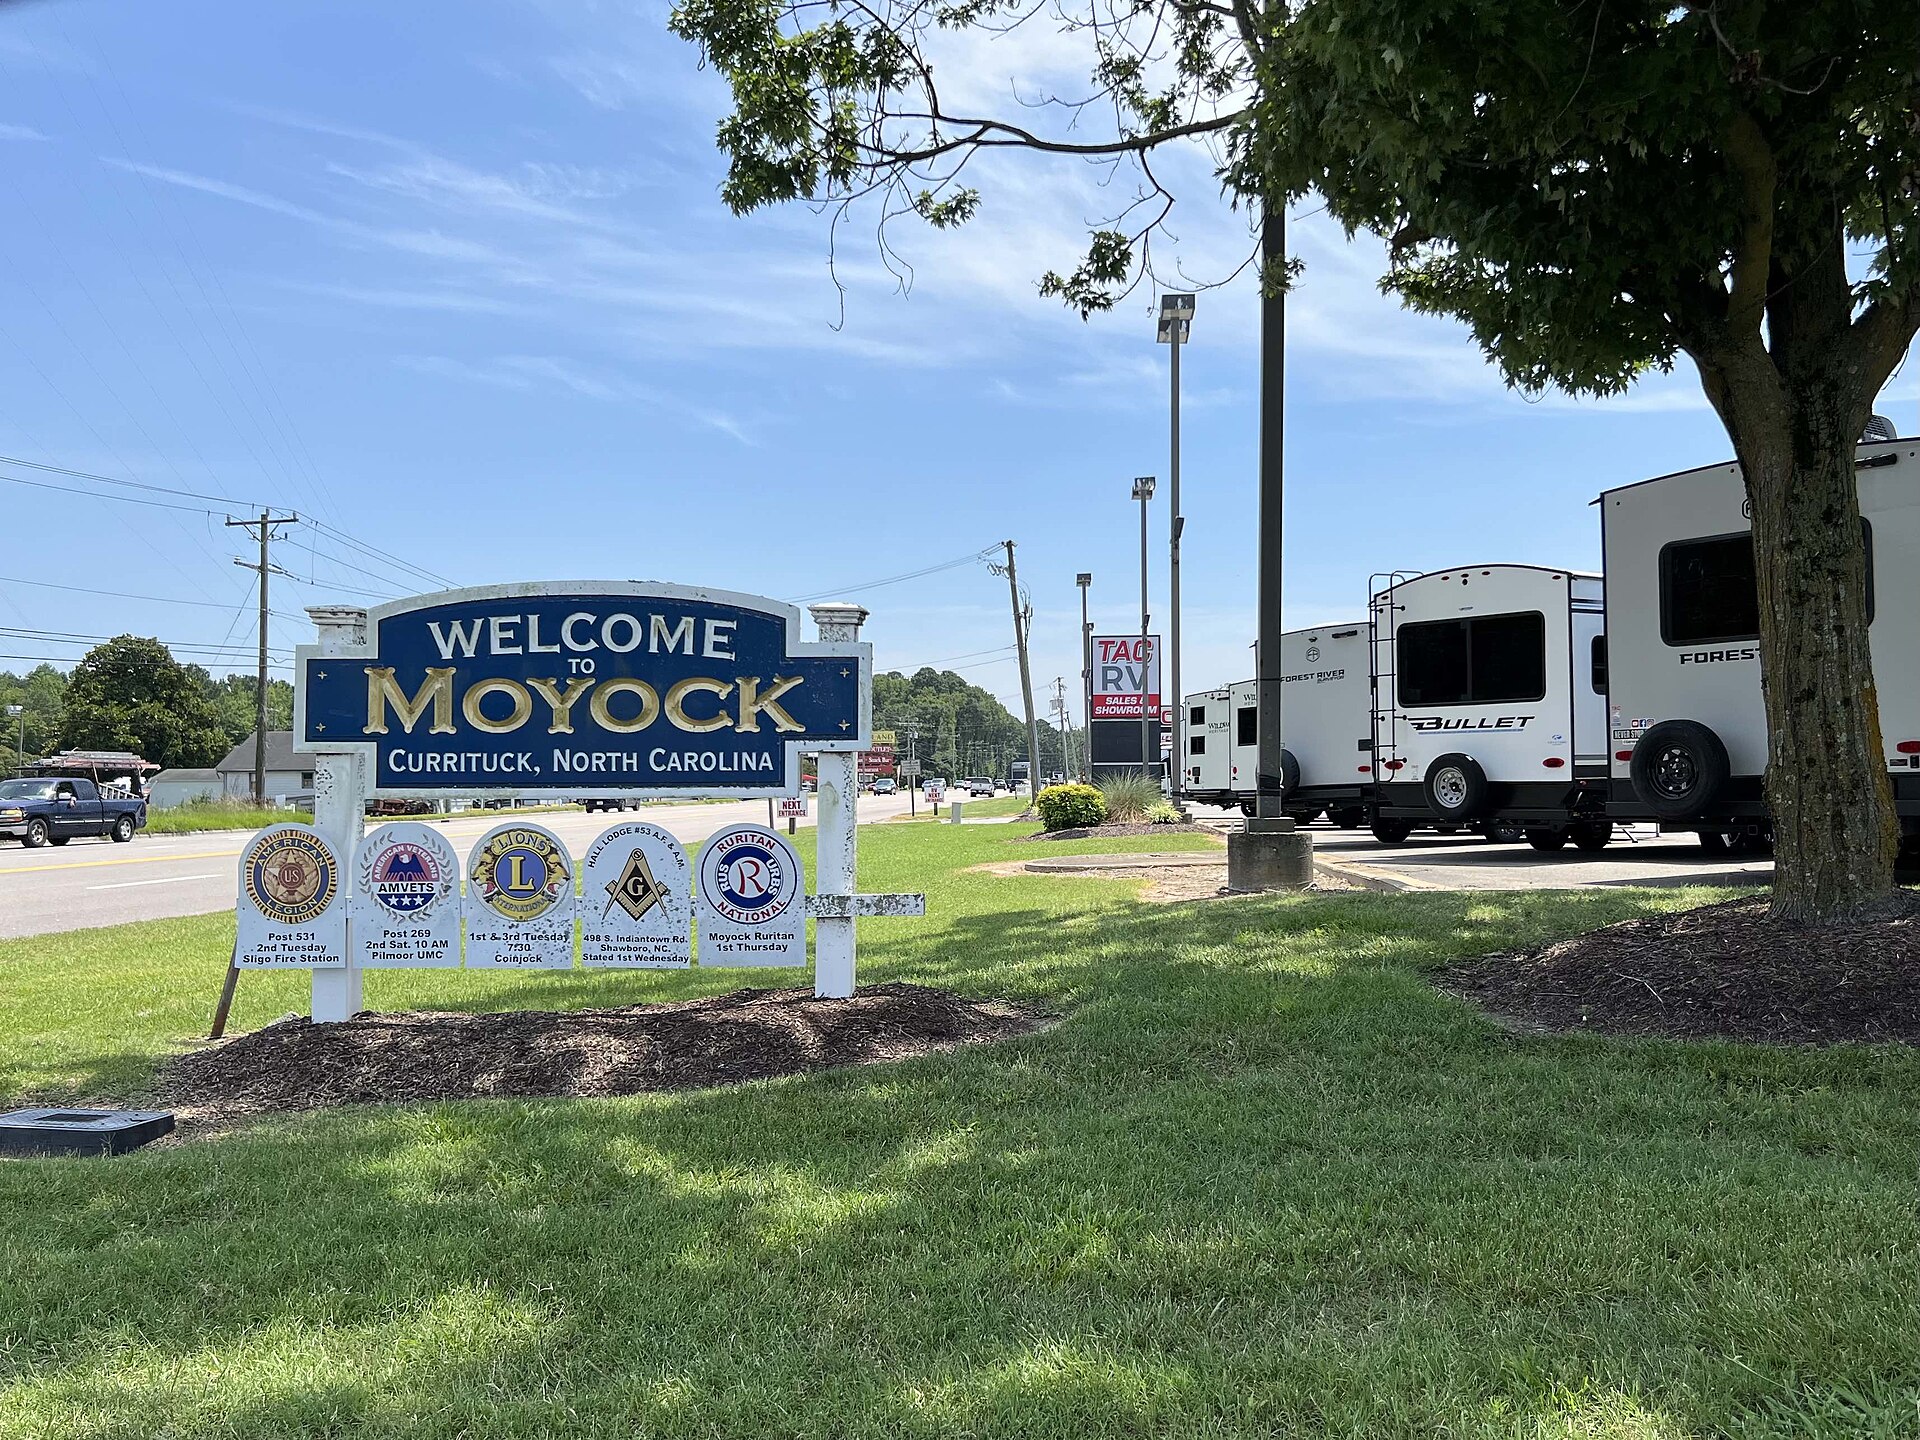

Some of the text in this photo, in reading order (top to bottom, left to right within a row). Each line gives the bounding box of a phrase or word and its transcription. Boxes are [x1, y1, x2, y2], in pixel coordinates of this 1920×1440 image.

[426, 611, 737, 661] WELCOME
[1679, 648, 1760, 665] FORES
[567, 658, 596, 675] TO
[1101, 665, 1150, 691] RV
[1280, 669, 1345, 682] FOREST RIVER
[362, 666, 806, 735] MOYOCK
[1105, 696, 1137, 705] SALES
[1408, 715, 1536, 730] BULLET
[388, 747, 774, 776] CURRITUCK, NORTH CAROLINA
[783, 801, 801, 809] NEXT
[498, 832, 548, 851] LIONS
[587, 846, 604, 868] HALL
[602, 827, 633, 846] LODGE
[634, 827, 651, 836] #53
[667, 842, 675, 850] &
[716, 834, 776, 852] RURITAN
[257, 839, 326, 867] AMERICAN
[374, 845, 438, 880] AMERICAN VETERANS
[284, 869, 299, 883] US
[508, 855, 536, 891] L
[718, 863, 731, 892] RUS
[737, 860, 765, 895] R
[766, 859, 780, 896] URBS
[378, 882, 435, 893] AMVETS
[626, 876, 645, 896] G
[266, 898, 318, 914] LEGION
[717, 900, 786, 921] NATIONAL
[268, 932, 315, 941] Post 531
[383, 929, 431, 938] Post 269
[469, 932, 569, 943] 1st & 3rd Tuesday
[583, 934, 688, 943] 498 S. Indiantown Rd.
[709, 932, 794, 942] Moyock Ruritan
[256, 943, 327, 954] 2nd Tuesday
[365, 939, 449, 949] 2nd Sat. 10 AM
[507, 943, 531, 952] 7:30
[600, 944, 671, 953] Shawboro, NC.
[716, 943, 788, 952] 1st Thursday
[242, 954, 340, 965] Sligo Fire Station
[371, 950, 444, 960] Pilmoor UMC
[494, 954, 543, 965] Coinjock
[582, 953, 689, 964] Stated 1st Wednesday
